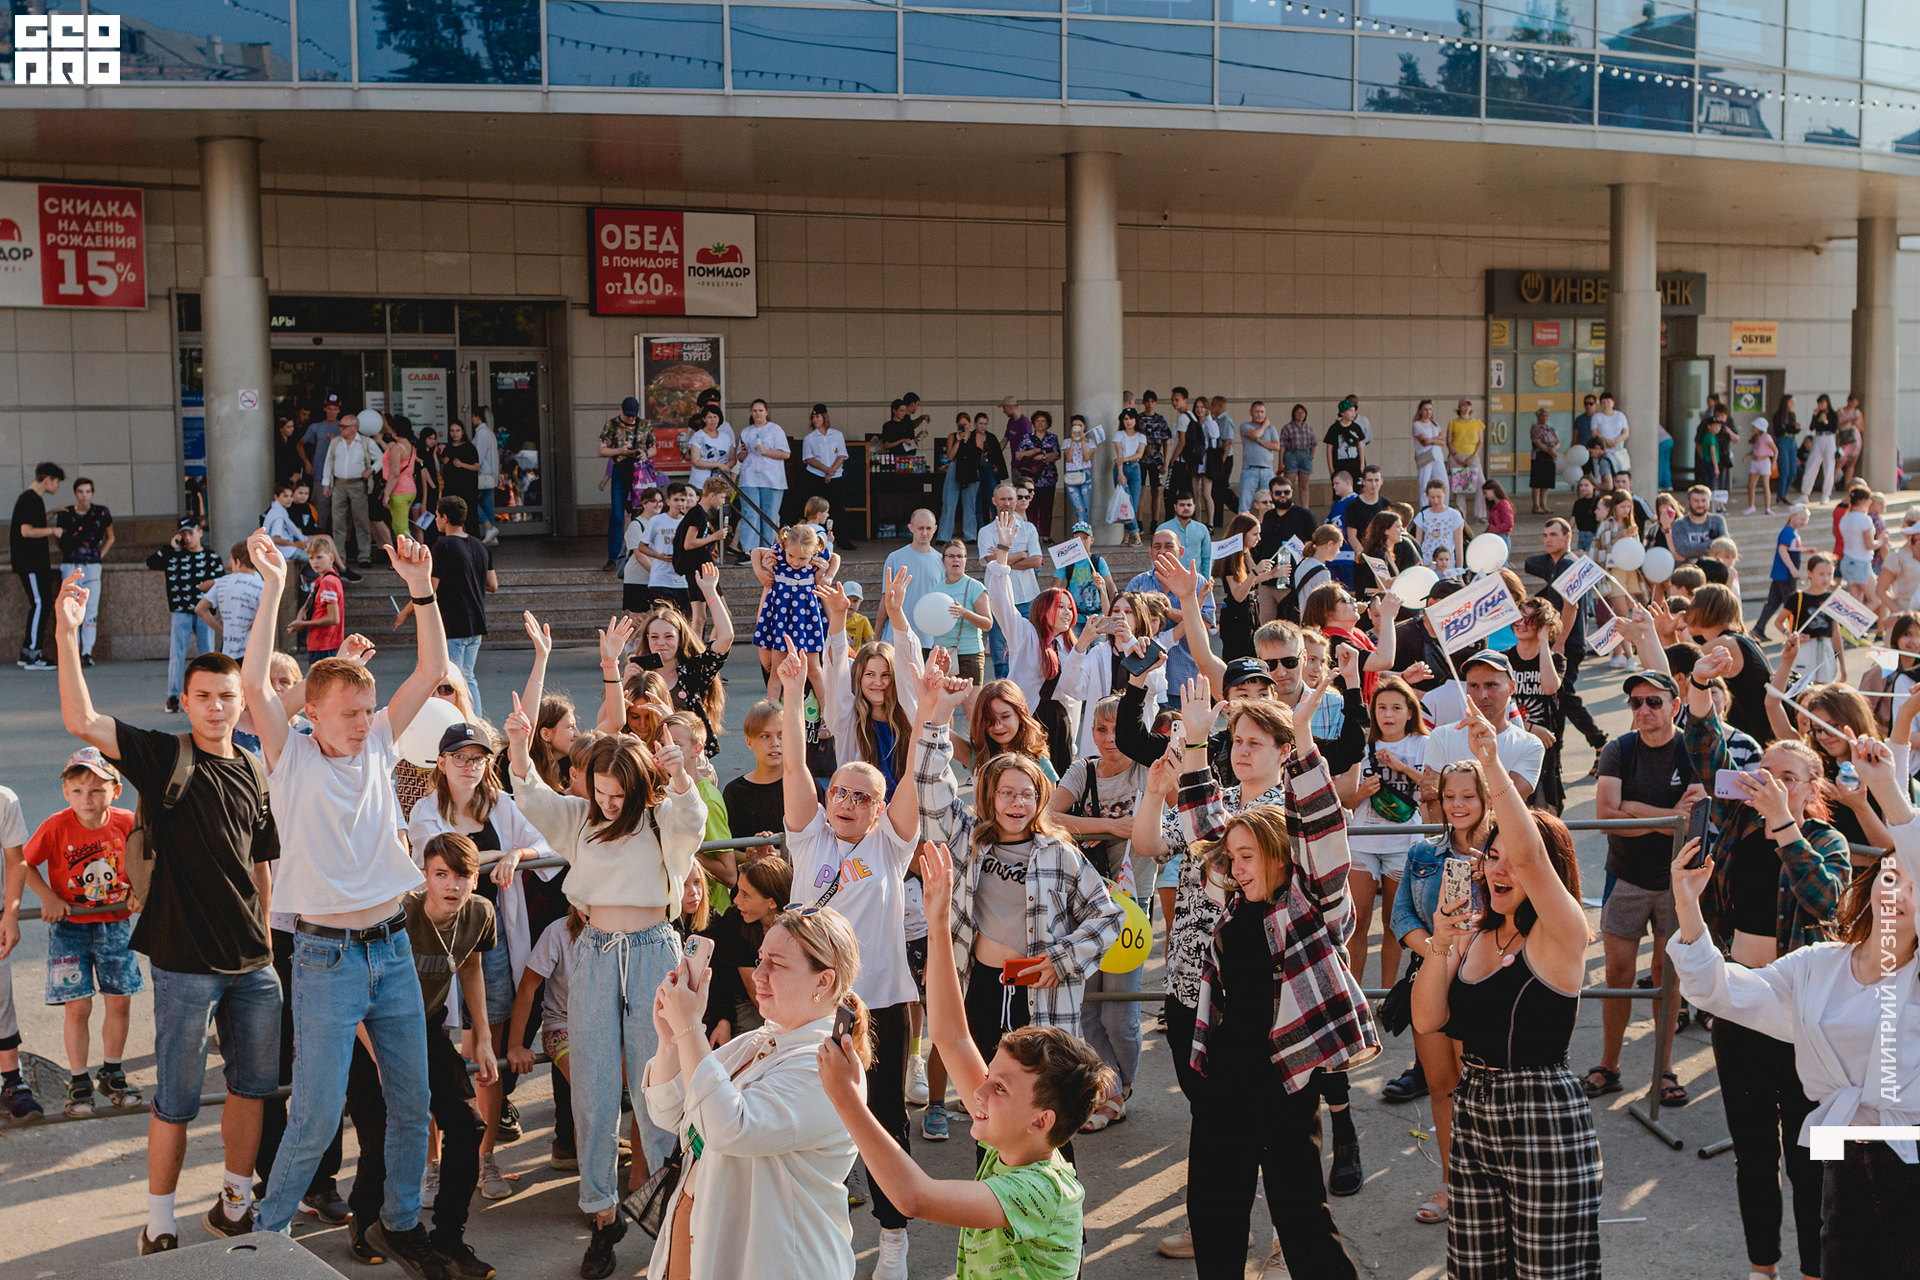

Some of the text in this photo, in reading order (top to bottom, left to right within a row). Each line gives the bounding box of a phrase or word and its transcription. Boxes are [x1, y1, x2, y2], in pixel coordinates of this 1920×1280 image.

[44, 197, 137, 218] СКИДКА
[58, 219, 125, 234] НА ДЕНЬ
[46, 233, 137, 249] РОЖДЕНИЯ
[601, 223, 679, 254] ОБЕД
[602, 256, 679, 269] В ПОМИДОРЕ
[57, 249, 136, 297] 15%
[688, 266, 751, 278] ПОМИДОР
[1742, 334, 1772, 344] ОБУВИ
[683, 343, 711, 351] САНДЕРС
[683, 352, 712, 361] БУРГЕР
[408, 373, 440, 381] СЛАВА
[1735, 386, 1761, 394] ОБУВИ
[658, 441, 675, 449] ЭТАЖ
[1441, 601, 1471, 629] INTER
[1515, 683, 1545, 696] ЛЬМ
[814, 858, 873, 892] PNE
[1117, 928, 1145, 949] 06
[415, 954, 448, 973] UMA
